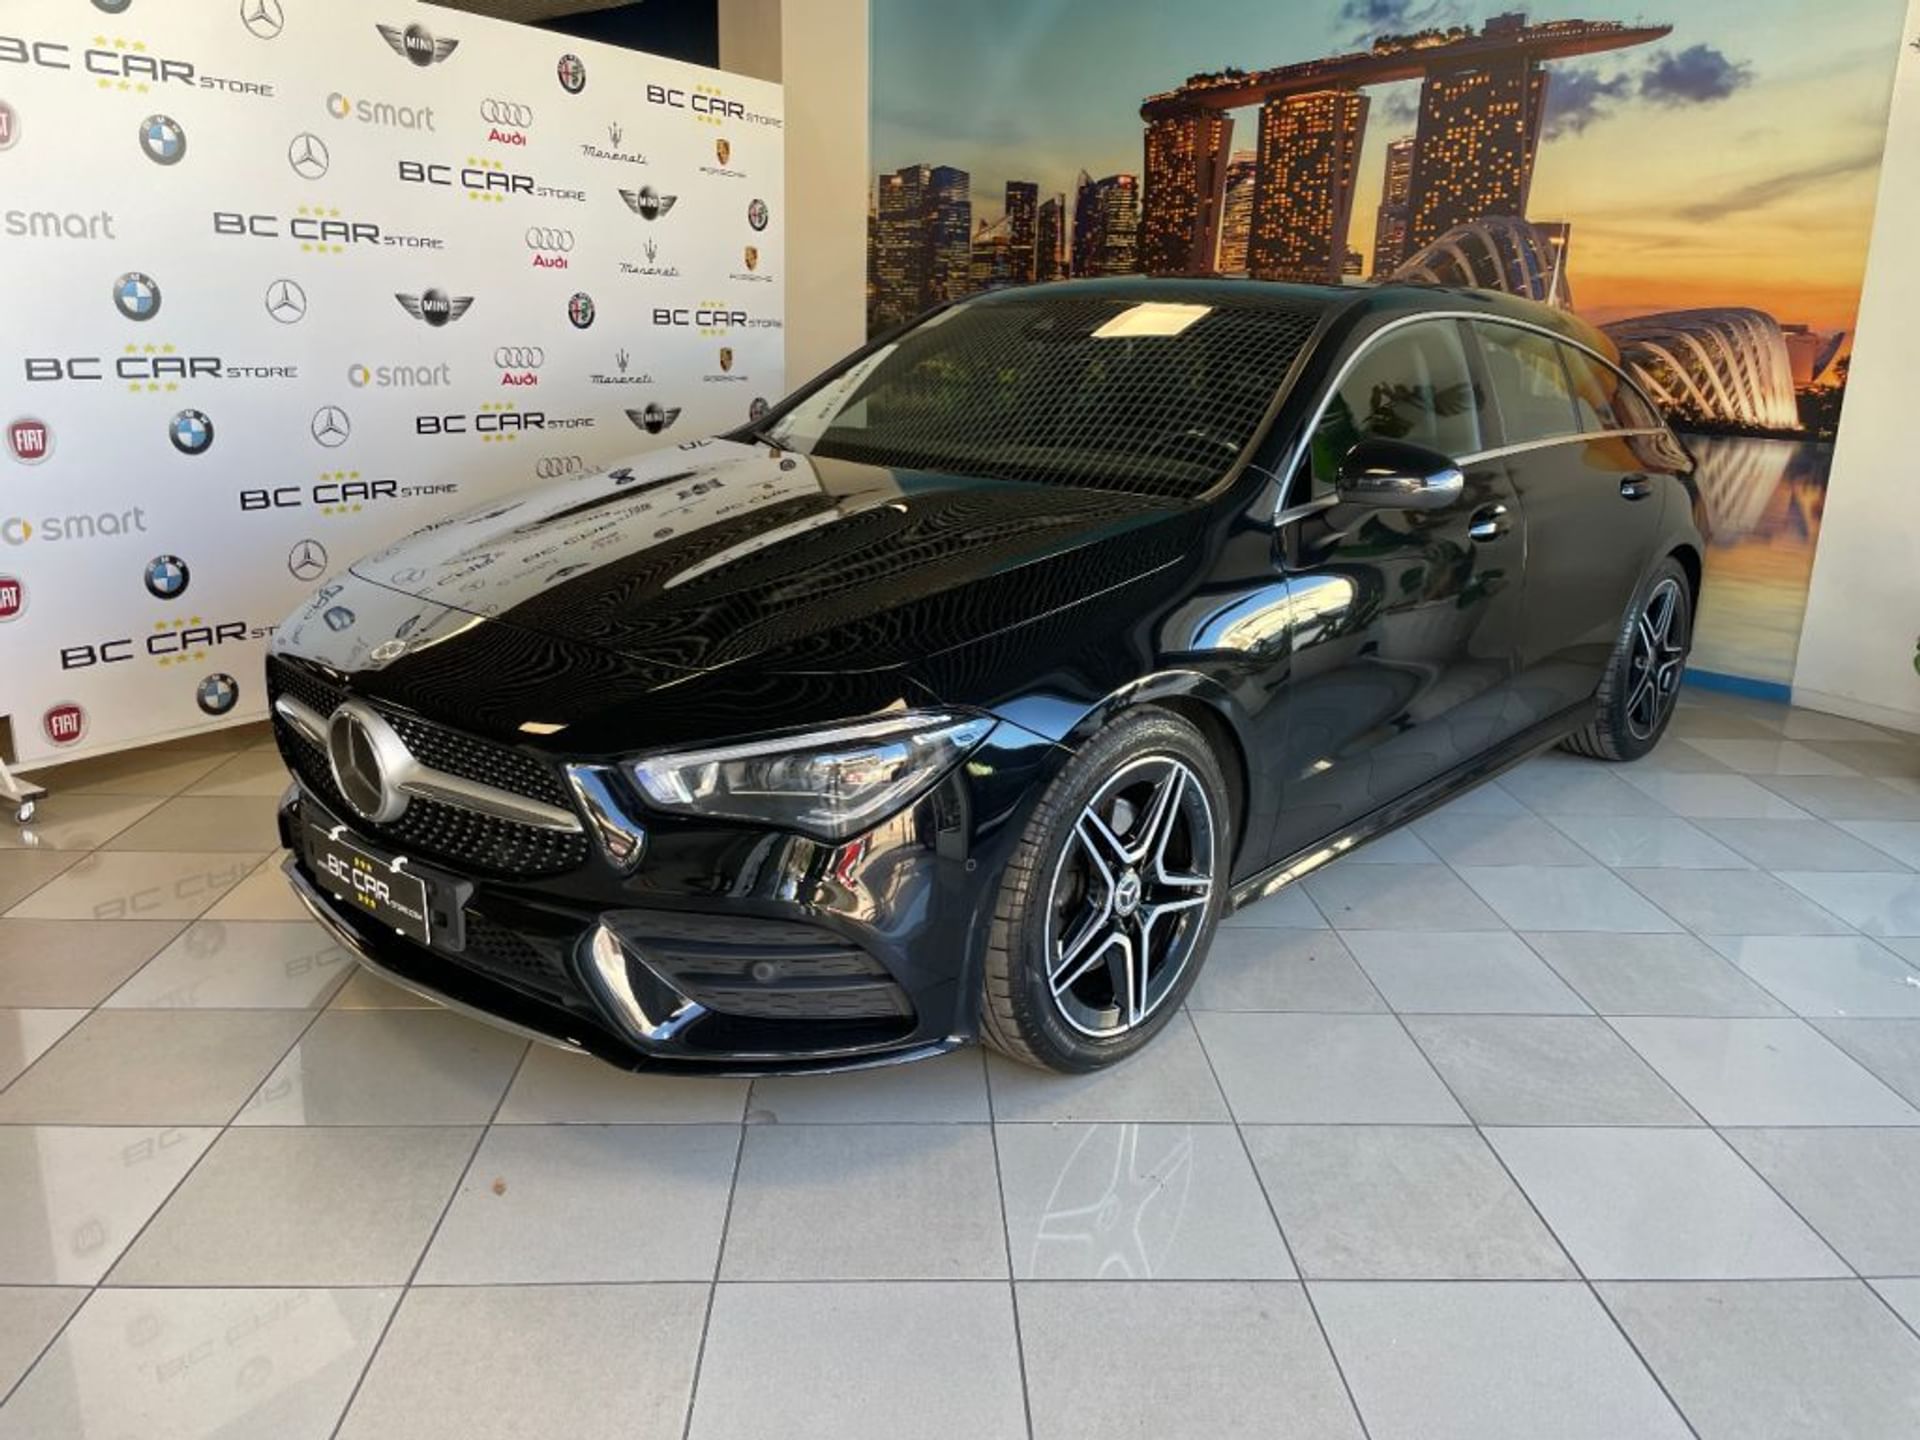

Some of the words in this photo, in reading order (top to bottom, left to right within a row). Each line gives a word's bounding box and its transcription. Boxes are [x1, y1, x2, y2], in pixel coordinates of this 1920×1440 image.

[406, 35, 434, 52] MINI
[84, 49, 197, 87] CAR
[200, 76, 275, 97] STORE
[646, 84, 685, 108] BC
[692, 95, 744, 120] CAR
[356, 99, 435, 132] smart
[488, 127, 527, 147] Audi
[398, 160, 452, 186] BC
[460, 170, 535, 195] CAR
[537, 186, 587, 202] STORE
[5, 209, 116, 240] smart
[213, 211, 279, 238] BC
[290, 217, 381, 244] CAR
[384, 235, 444, 249] STORE
[533, 253, 568, 270] Audi
[423, 299, 449, 313] MINI
[652, 308, 689, 327] BC
[695, 310, 748, 328] CAR
[25, 357, 103, 382] BC
[116, 356, 223, 379] CAR
[226, 366, 298, 379] STORE
[376, 362, 451, 388] smart
[501, 371, 538, 387] Audi
[415, 415, 467, 434] BC
[475, 411, 546, 431] CAR
[547, 416, 595, 429] STORE
[15, 429, 44, 451] FIAT
[239, 487, 301, 511] BC
[312, 479, 398, 504] CAR
[400, 483, 459, 498] STORE
[41, 506, 147, 541] smart
[60, 638, 134, 671] BC
[146, 621, 248, 656] CAR
[251, 626, 281, 640] ST
[51, 713, 80, 737] FIAT
[327, 853, 351, 884] BC
[352, 867, 391, 905] CAR
